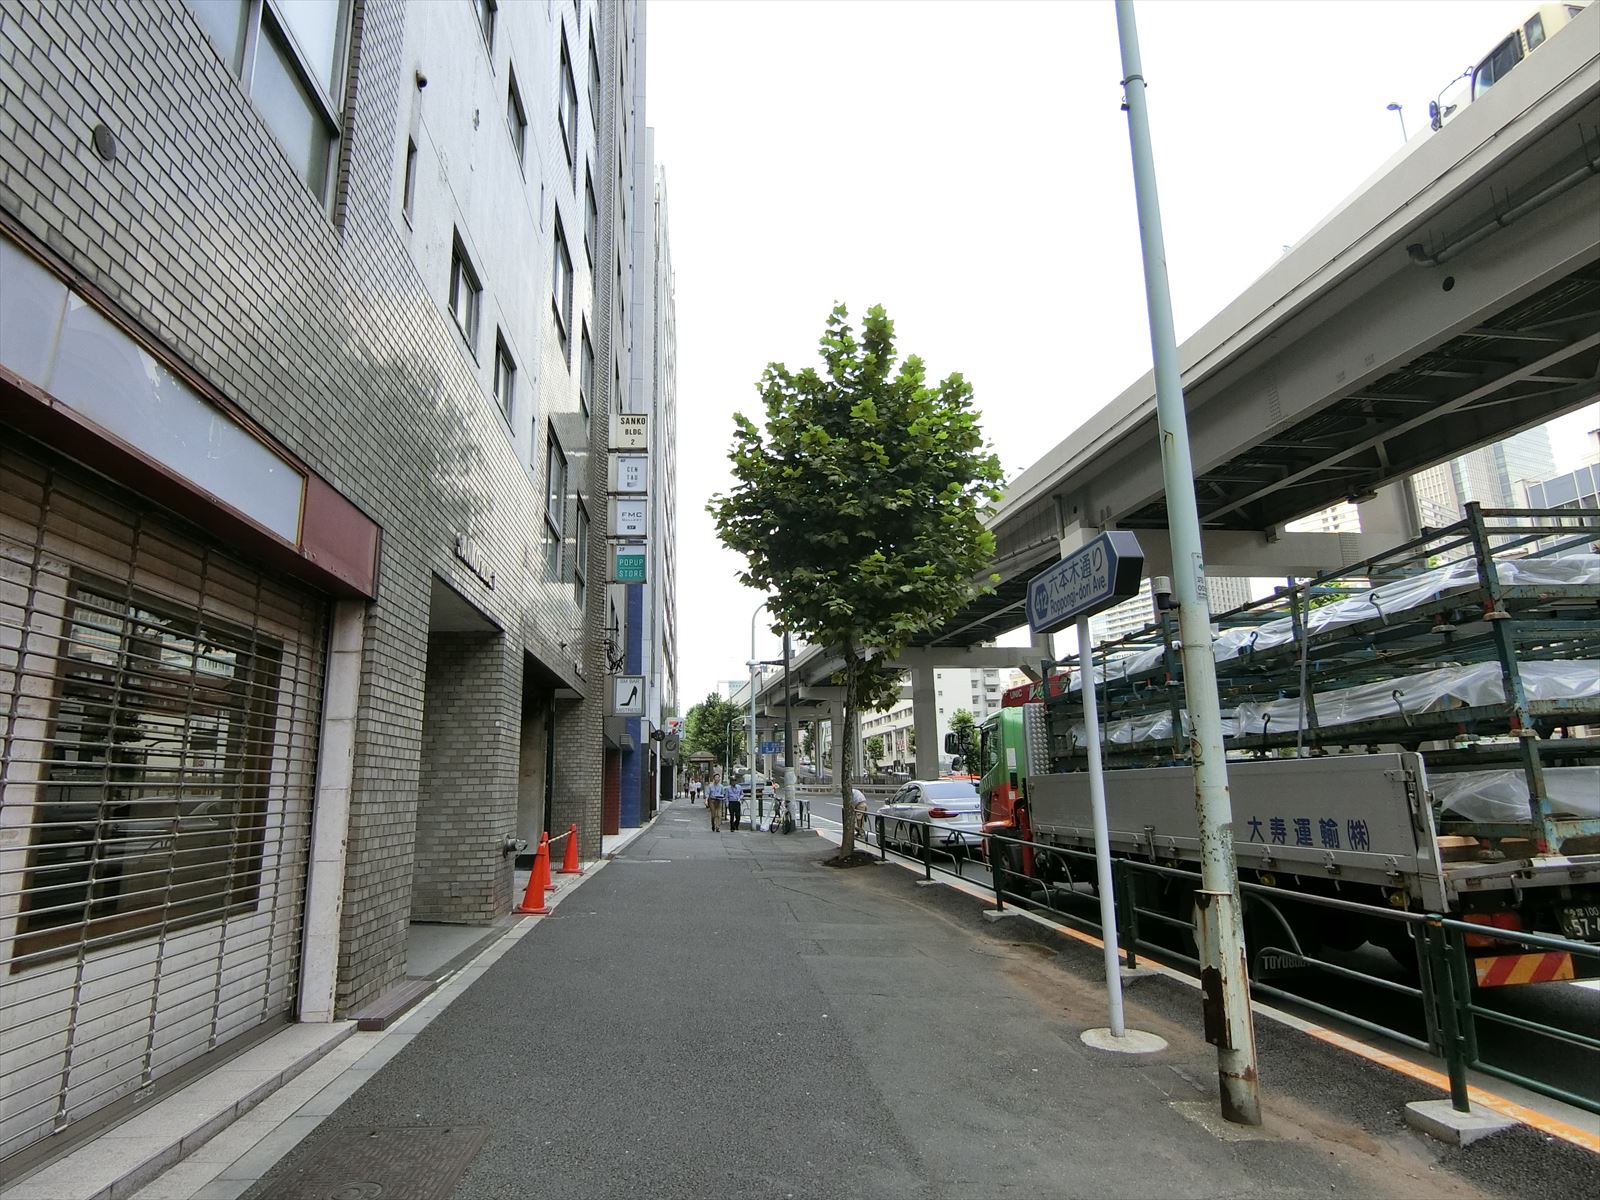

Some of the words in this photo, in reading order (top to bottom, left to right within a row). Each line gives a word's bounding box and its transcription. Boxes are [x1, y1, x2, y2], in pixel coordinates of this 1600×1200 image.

[620, 417, 646, 425] SANKO
[619, 558, 643, 566] POPUP
[1048, 546, 1103, 597] 六本木通り
[1034, 590, 1048, 610] 412
[1050, 579, 1091, 616] Roppongi-dori
[1092, 574, 1107, 593] Ave.
